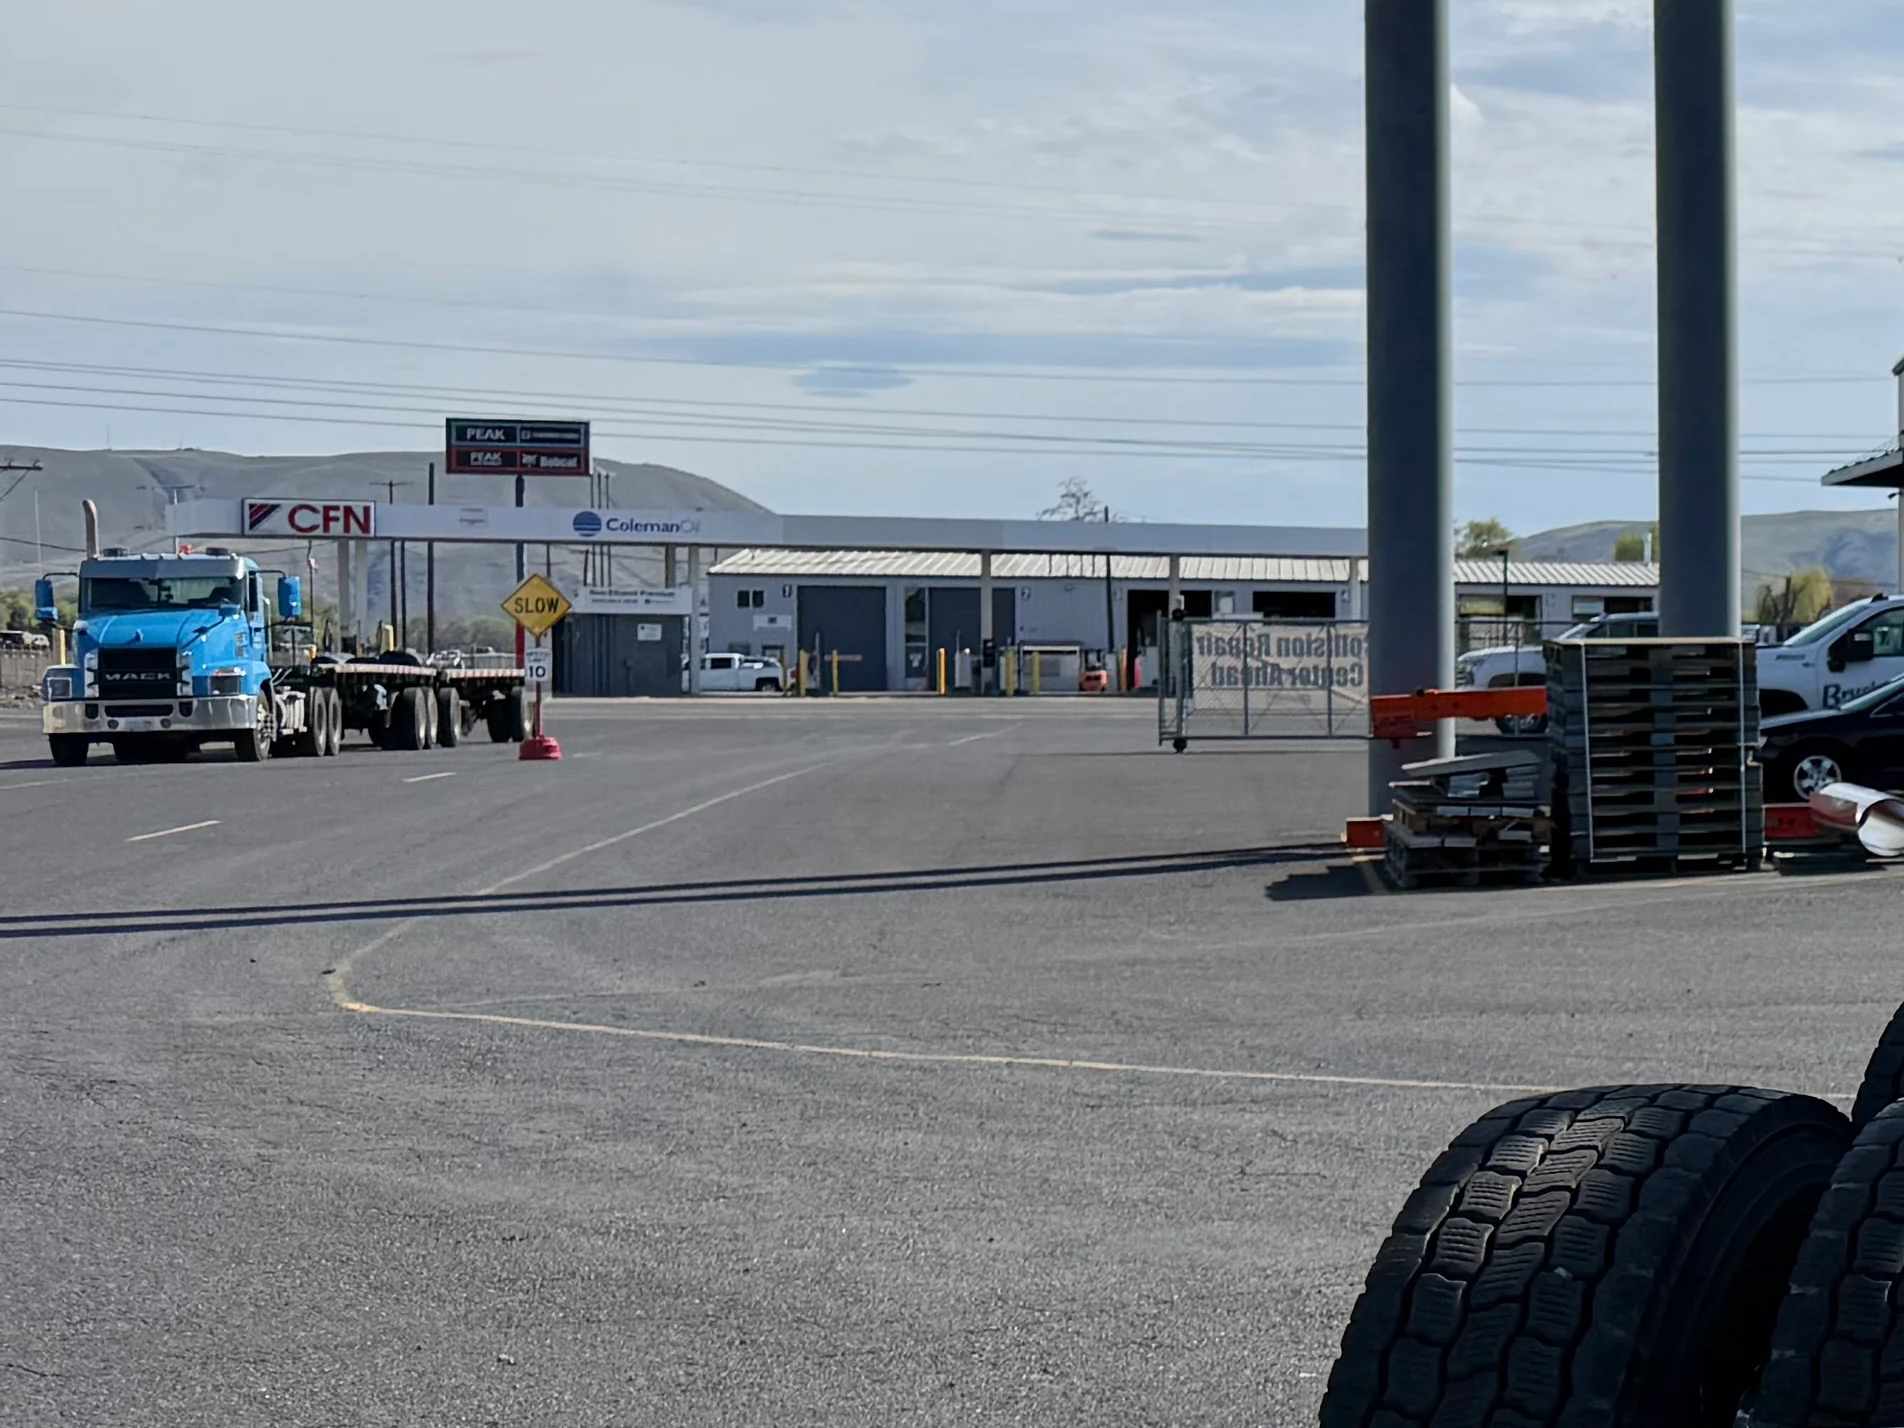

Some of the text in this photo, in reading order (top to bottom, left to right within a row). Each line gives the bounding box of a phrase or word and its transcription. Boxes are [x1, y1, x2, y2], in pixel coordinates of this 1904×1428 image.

[466, 427, 505, 440] PEAK
[287, 503, 372, 535] CFN
[514, 597, 560, 614] SLOW
[529, 665, 546, 678] 10
